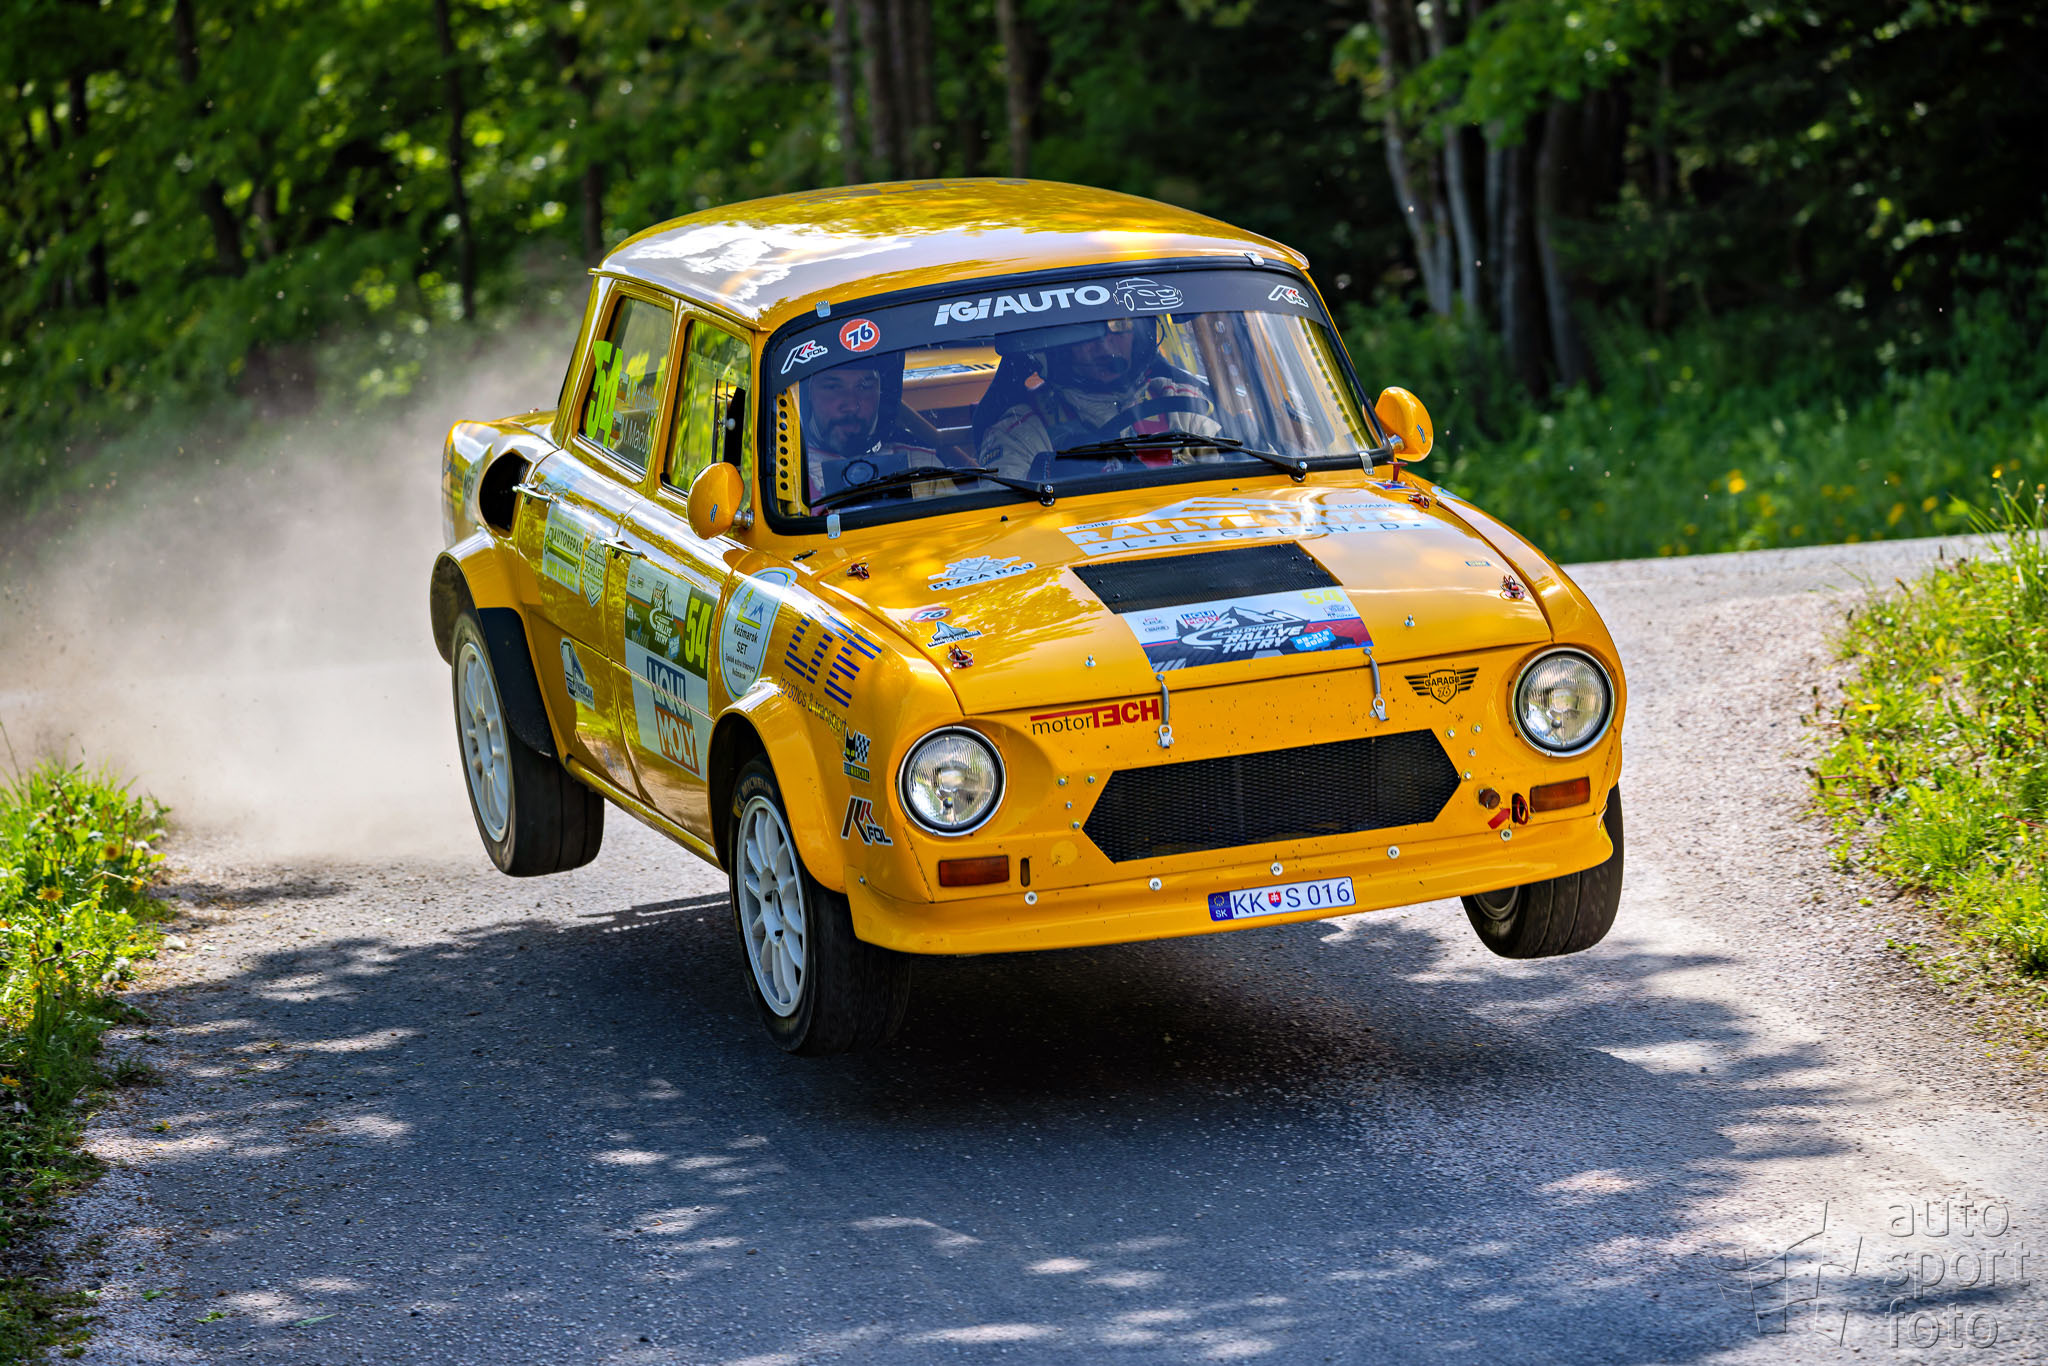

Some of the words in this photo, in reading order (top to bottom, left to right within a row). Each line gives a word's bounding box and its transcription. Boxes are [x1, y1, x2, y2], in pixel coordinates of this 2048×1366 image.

[846, 322, 875, 350] 76
[586, 340, 623, 449] 54
[1066, 514, 1261, 545] RALLYE
[932, 572, 990, 590] PIZZA
[995, 562, 1034, 576] RAJ
[1302, 589, 1343, 605] 54
[684, 596, 712, 669] 54
[733, 624, 759, 644] Kežmarok
[1225, 625, 1304, 644] RALLYE
[736, 641, 748, 656] SET
[1222, 636, 1290, 654] TATRY
[647, 658, 692, 724] LIQUI
[778, 672, 807, 708] logistics
[1425, 676, 1460, 687] GARAGE
[1437, 684, 1452, 698] 76
[656, 708, 698, 772] MOLY
[866, 824, 893, 845] FOL
[1232, 891, 1267, 914] KK
[1285, 887, 1301, 908] S
[1307, 881, 1350, 906] 016
[1215, 909, 1228, 918] SK
